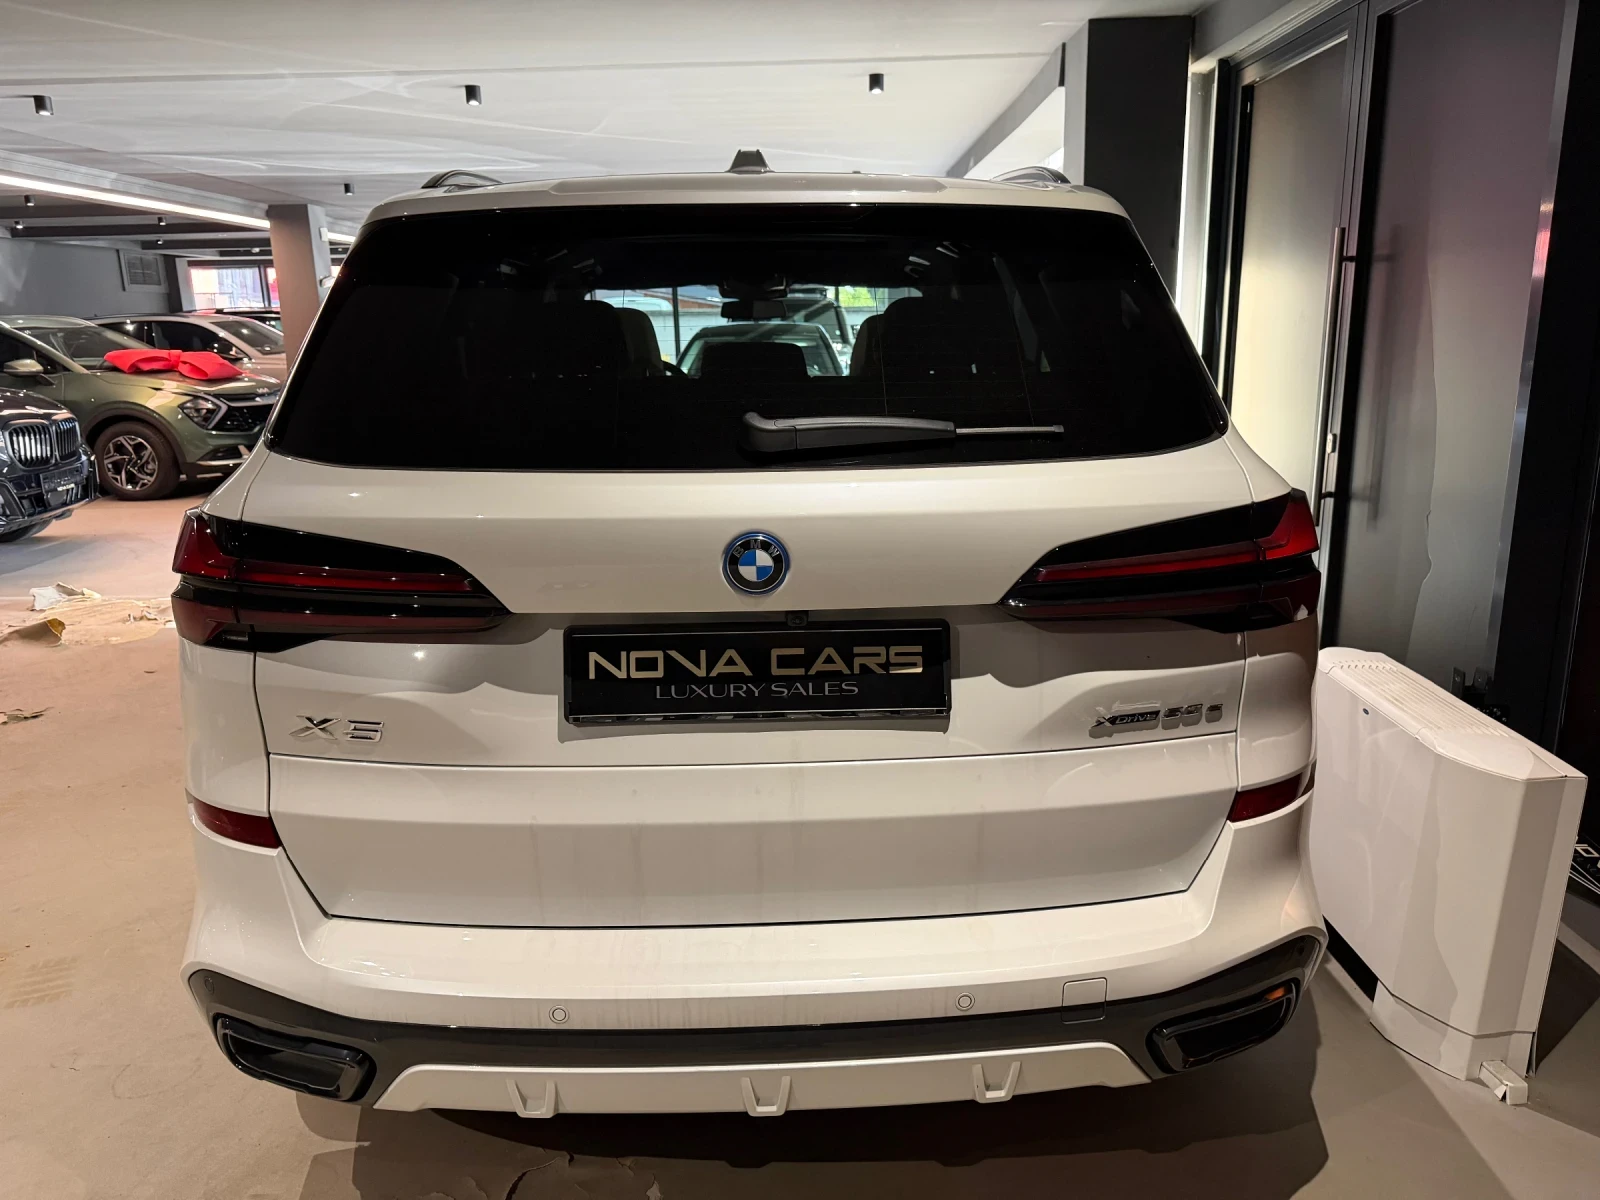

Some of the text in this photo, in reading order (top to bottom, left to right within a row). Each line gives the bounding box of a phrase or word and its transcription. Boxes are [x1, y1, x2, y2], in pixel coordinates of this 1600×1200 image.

[732, 539, 780, 558] BMW
[588, 645, 923, 680] NOVA CARS
[655, 681, 859, 699] LUXURY SALES
[289, 715, 385, 743] X5
